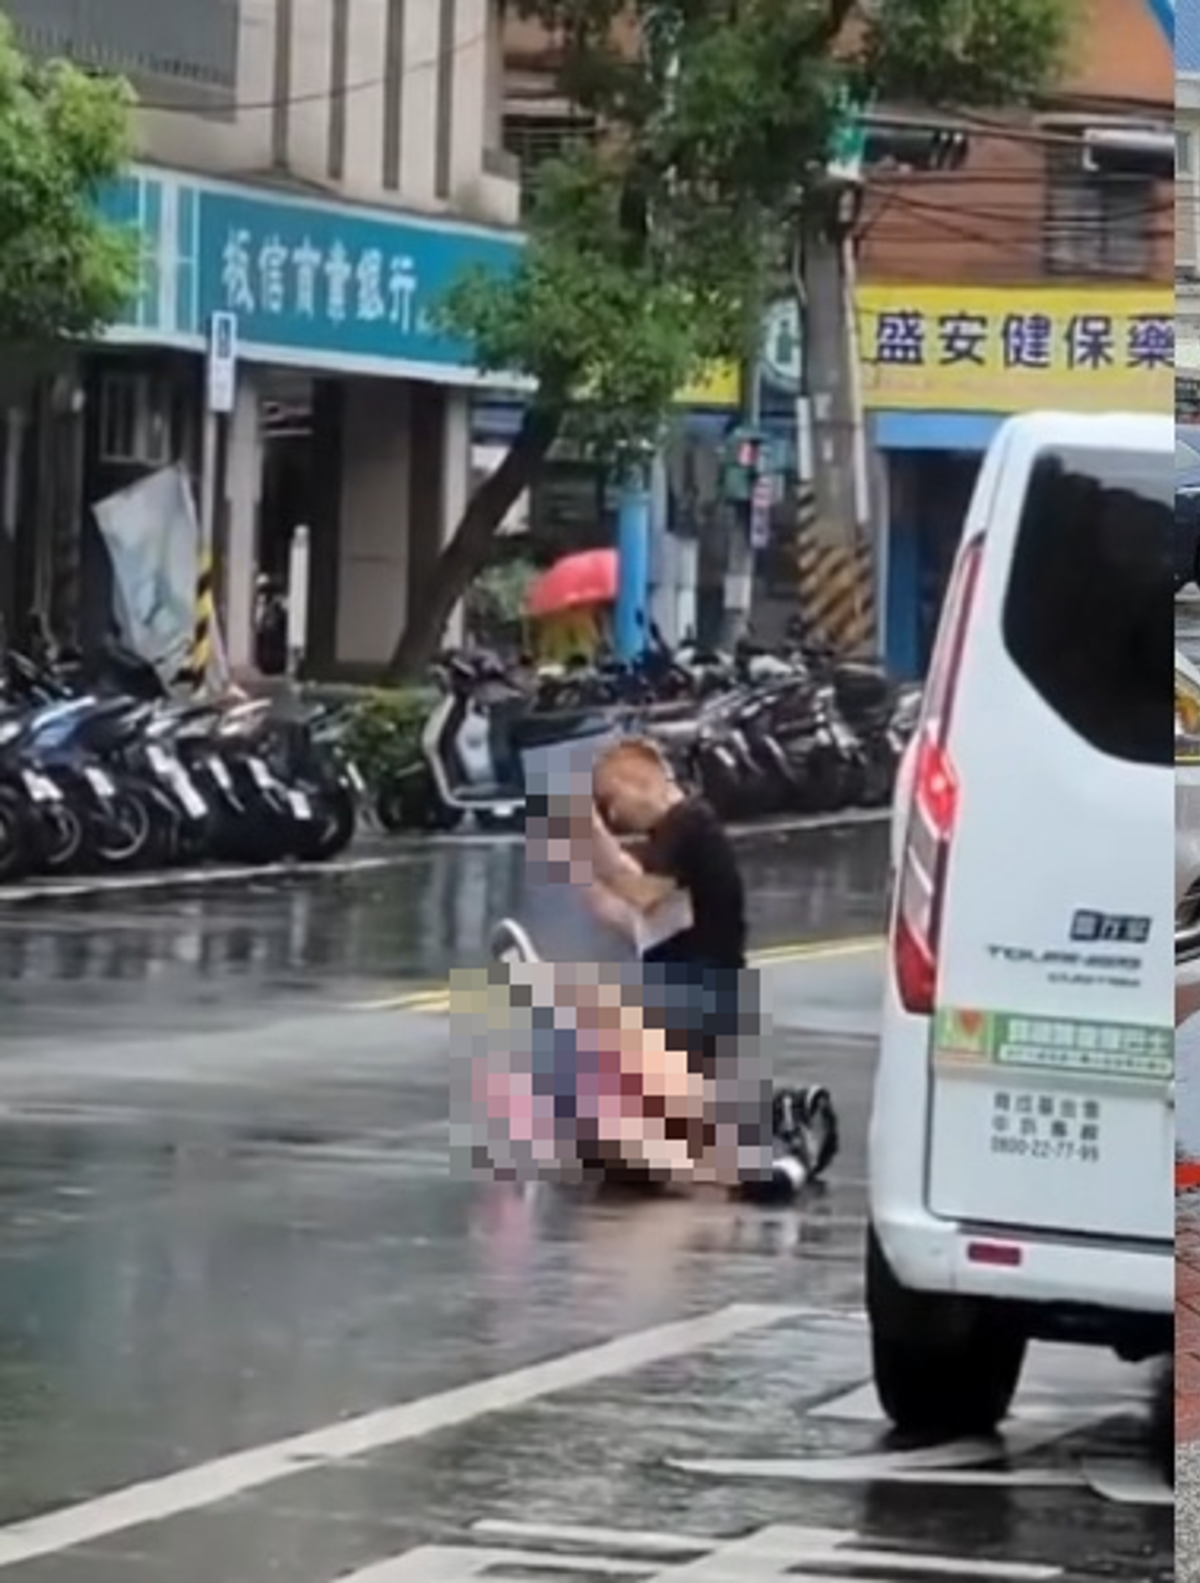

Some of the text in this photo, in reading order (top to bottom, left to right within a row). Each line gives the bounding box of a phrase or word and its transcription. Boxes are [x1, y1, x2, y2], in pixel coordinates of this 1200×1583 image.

[873, 310, 1174, 370] 盛安健保藥
